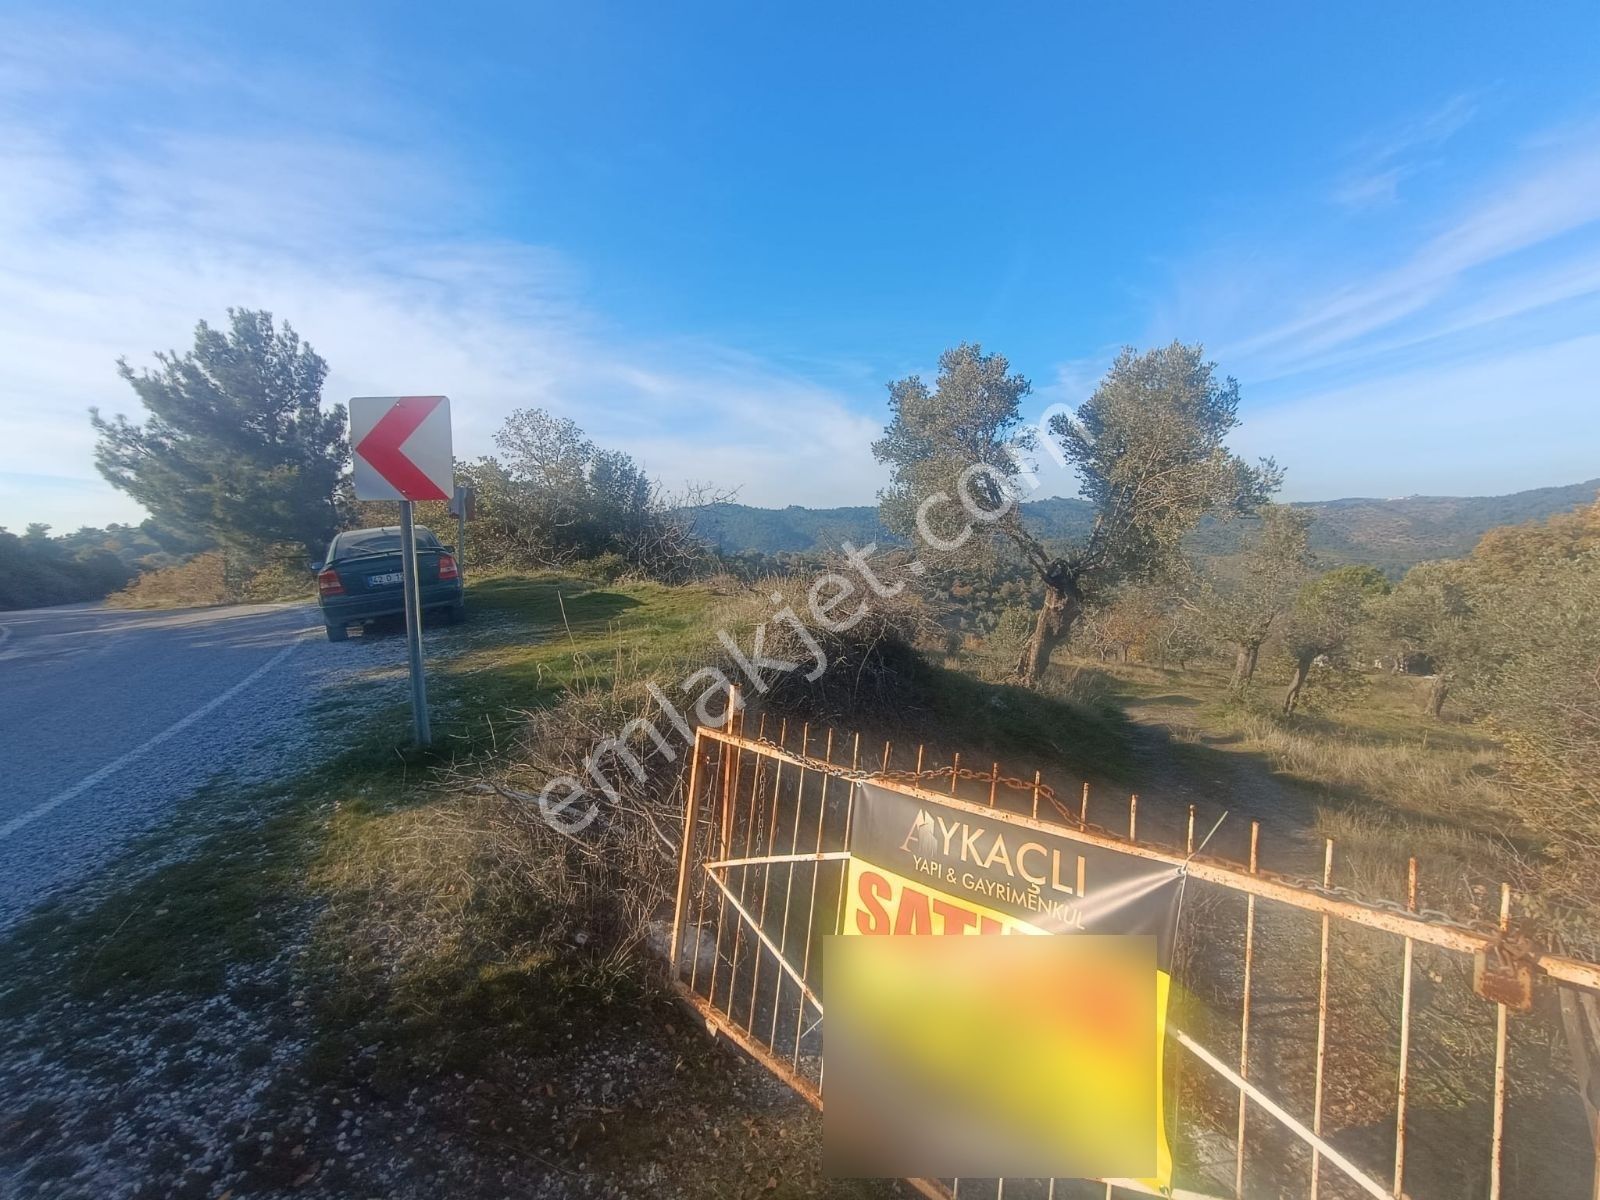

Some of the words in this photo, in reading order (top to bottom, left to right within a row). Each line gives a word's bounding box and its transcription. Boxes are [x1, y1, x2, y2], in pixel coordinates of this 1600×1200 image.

[900, 809, 1086, 898] AYKAÇLI
[912, 855, 942, 879] YAPI
[946, 868, 957, 884] &
[962, 873, 1085, 930] GAYRİMENKUL
